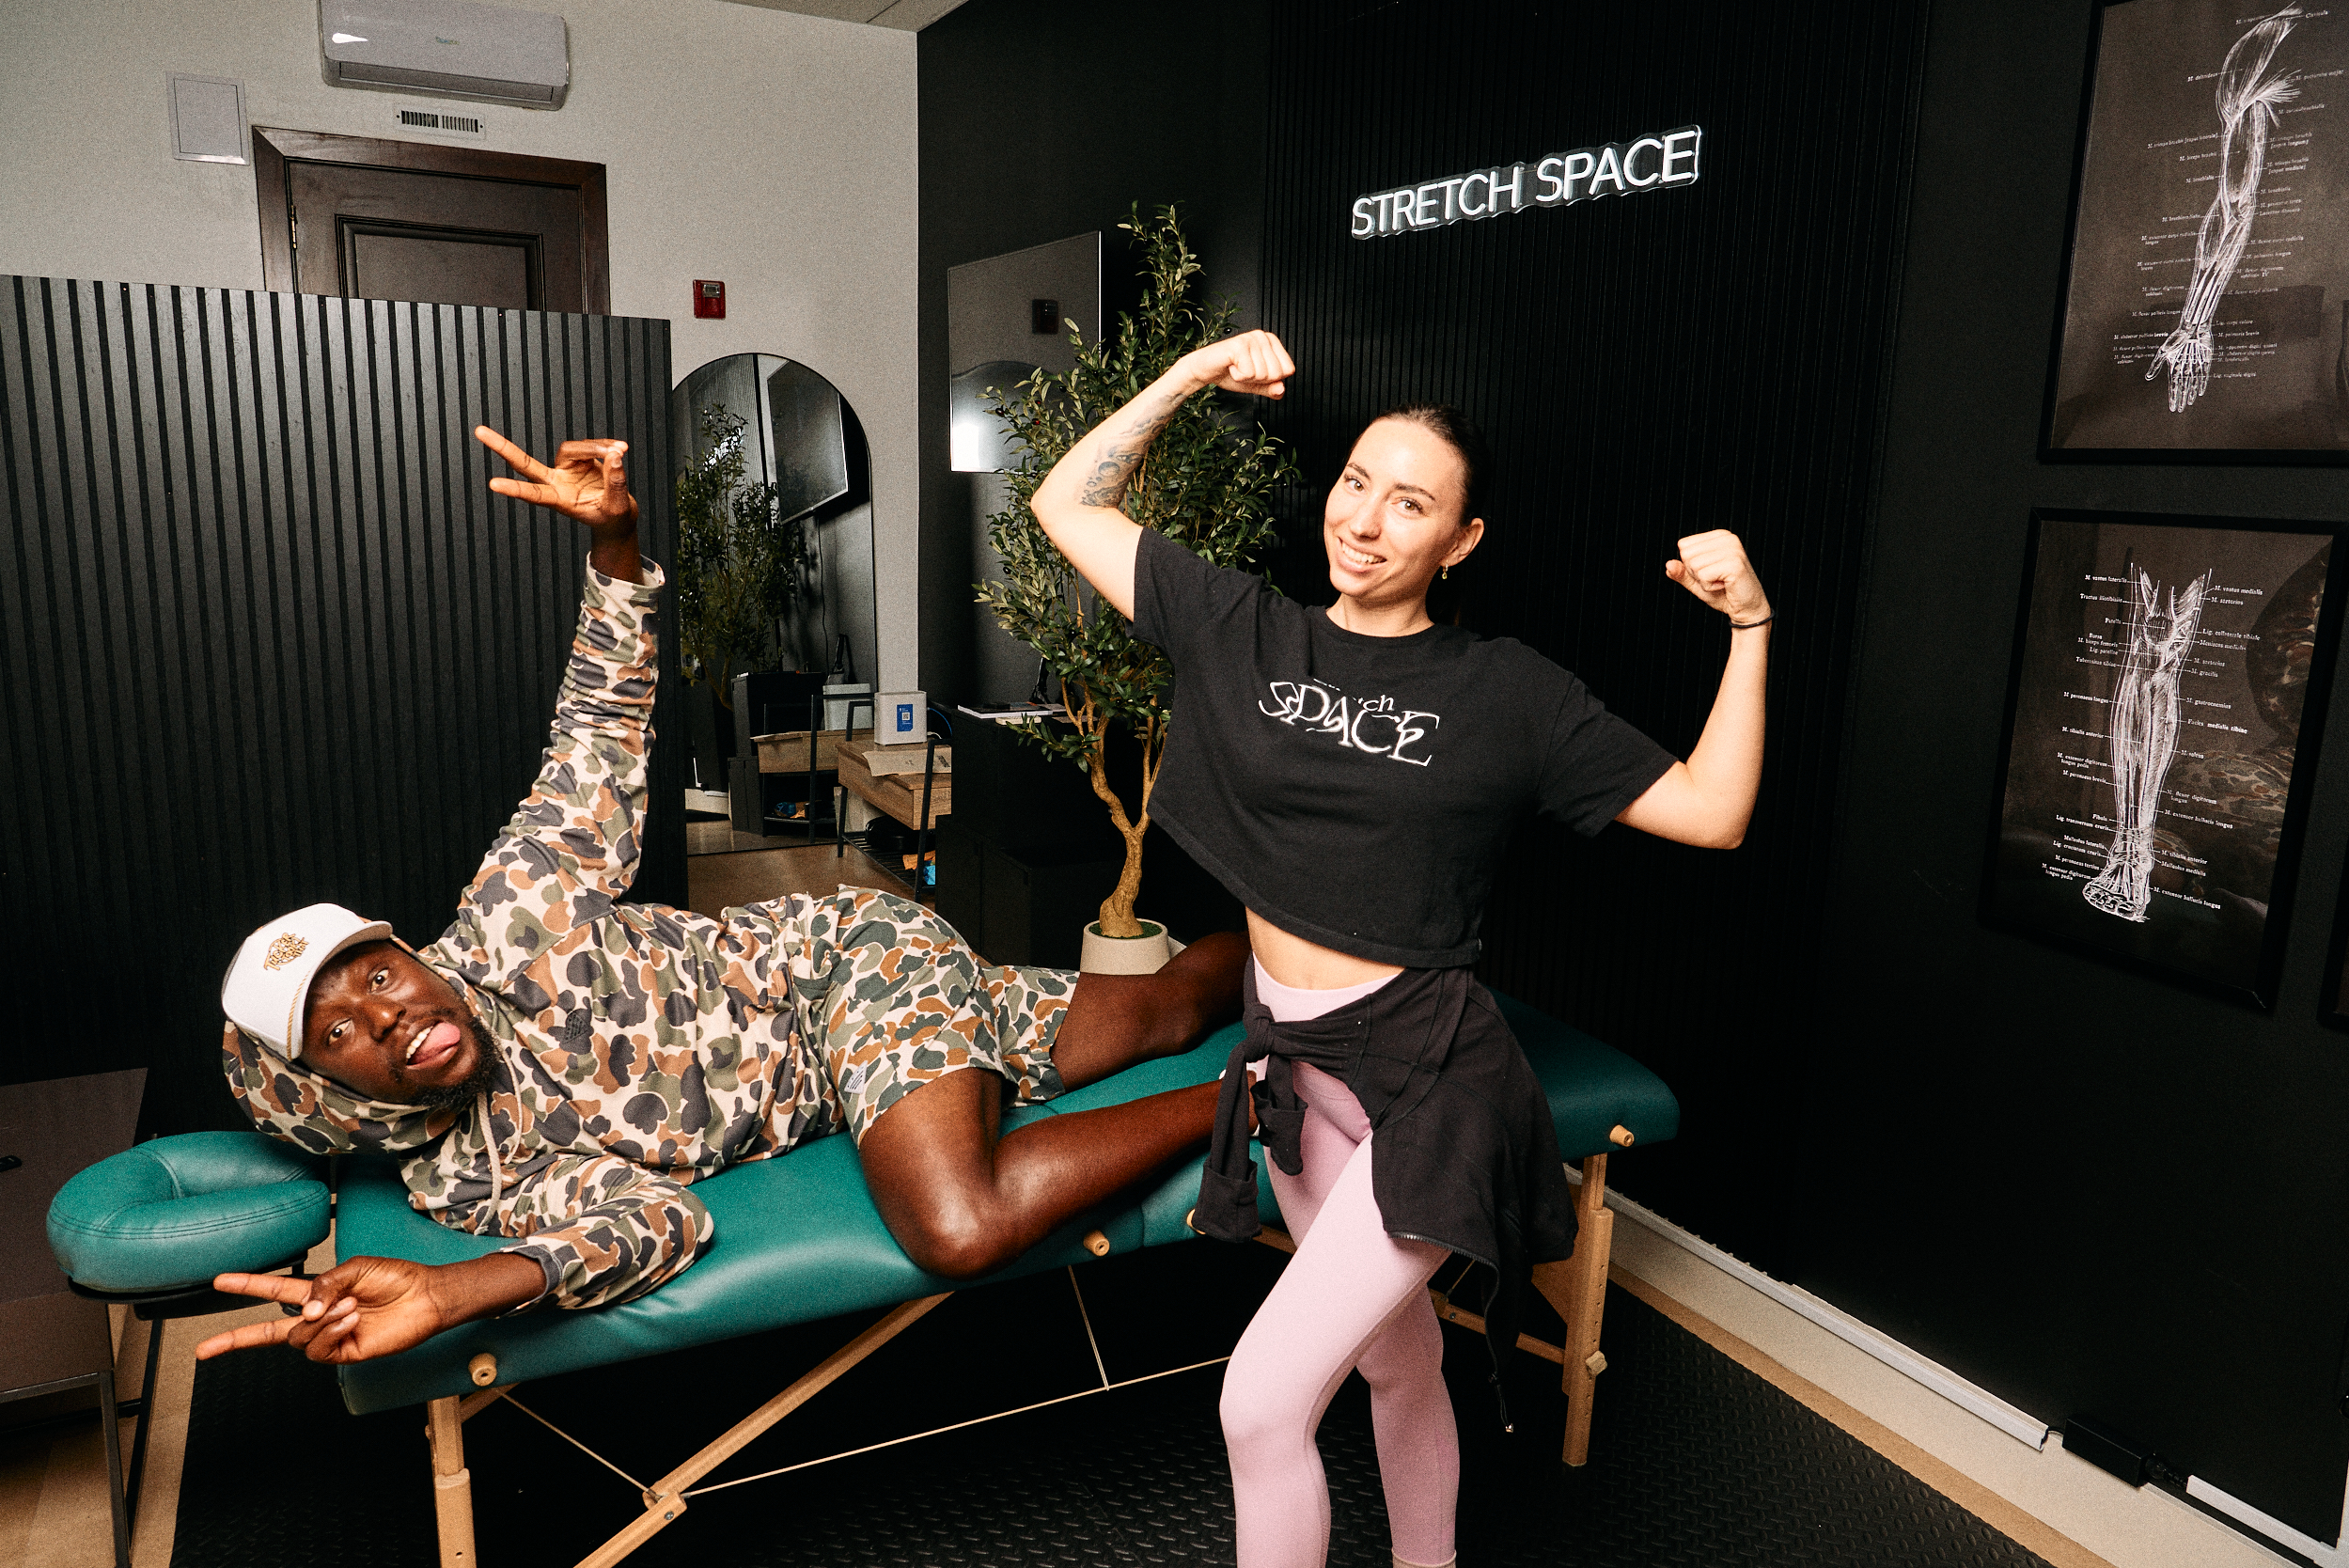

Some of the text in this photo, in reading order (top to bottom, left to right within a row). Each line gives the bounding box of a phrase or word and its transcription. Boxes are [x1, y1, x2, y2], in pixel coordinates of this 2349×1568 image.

[1352, 130, 1696, 235] STRETCH SPACE
[263, 932, 296, 971] TUCKER
